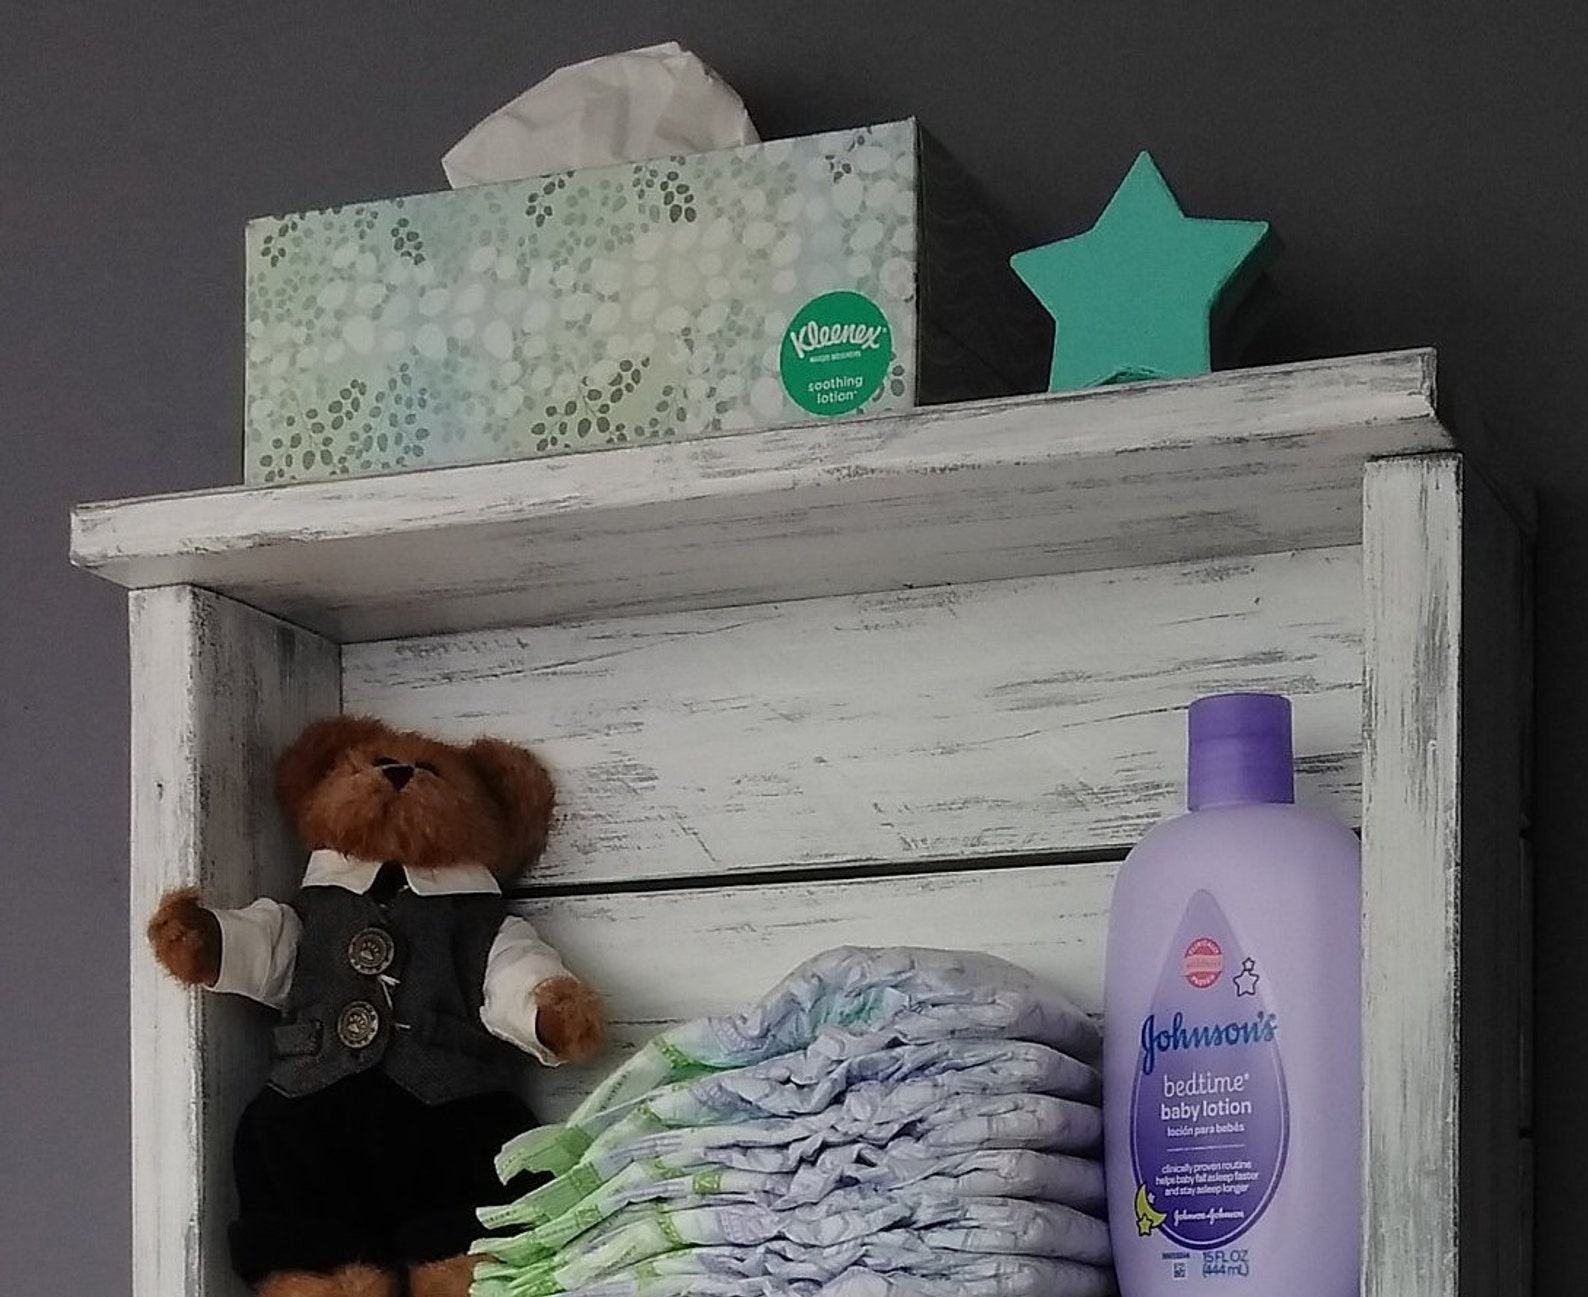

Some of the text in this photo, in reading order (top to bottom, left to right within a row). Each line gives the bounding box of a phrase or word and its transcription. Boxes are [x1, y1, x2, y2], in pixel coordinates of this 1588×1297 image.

[790, 321, 882, 358] Kleenex
[808, 376, 863, 391] soothing
[817, 391, 854, 404] lotion
[1141, 1011, 1277, 1075] Johnson's
[1163, 1072, 1244, 1097] bedtime
[1161, 1098, 1251, 1122] baby lotion
[1194, 1125, 1215, 1137] para
[1193, 1163, 1221, 1173] proven
[1221, 1161, 1252, 1170] routine
[1155, 1171, 1259, 1186] helps baby fall asleep faster
[1164, 1183, 1249, 1196] and stay asleep longer
[1203, 1252, 1214, 1263] 15
[1230, 1249, 1249, 1262] OZ
